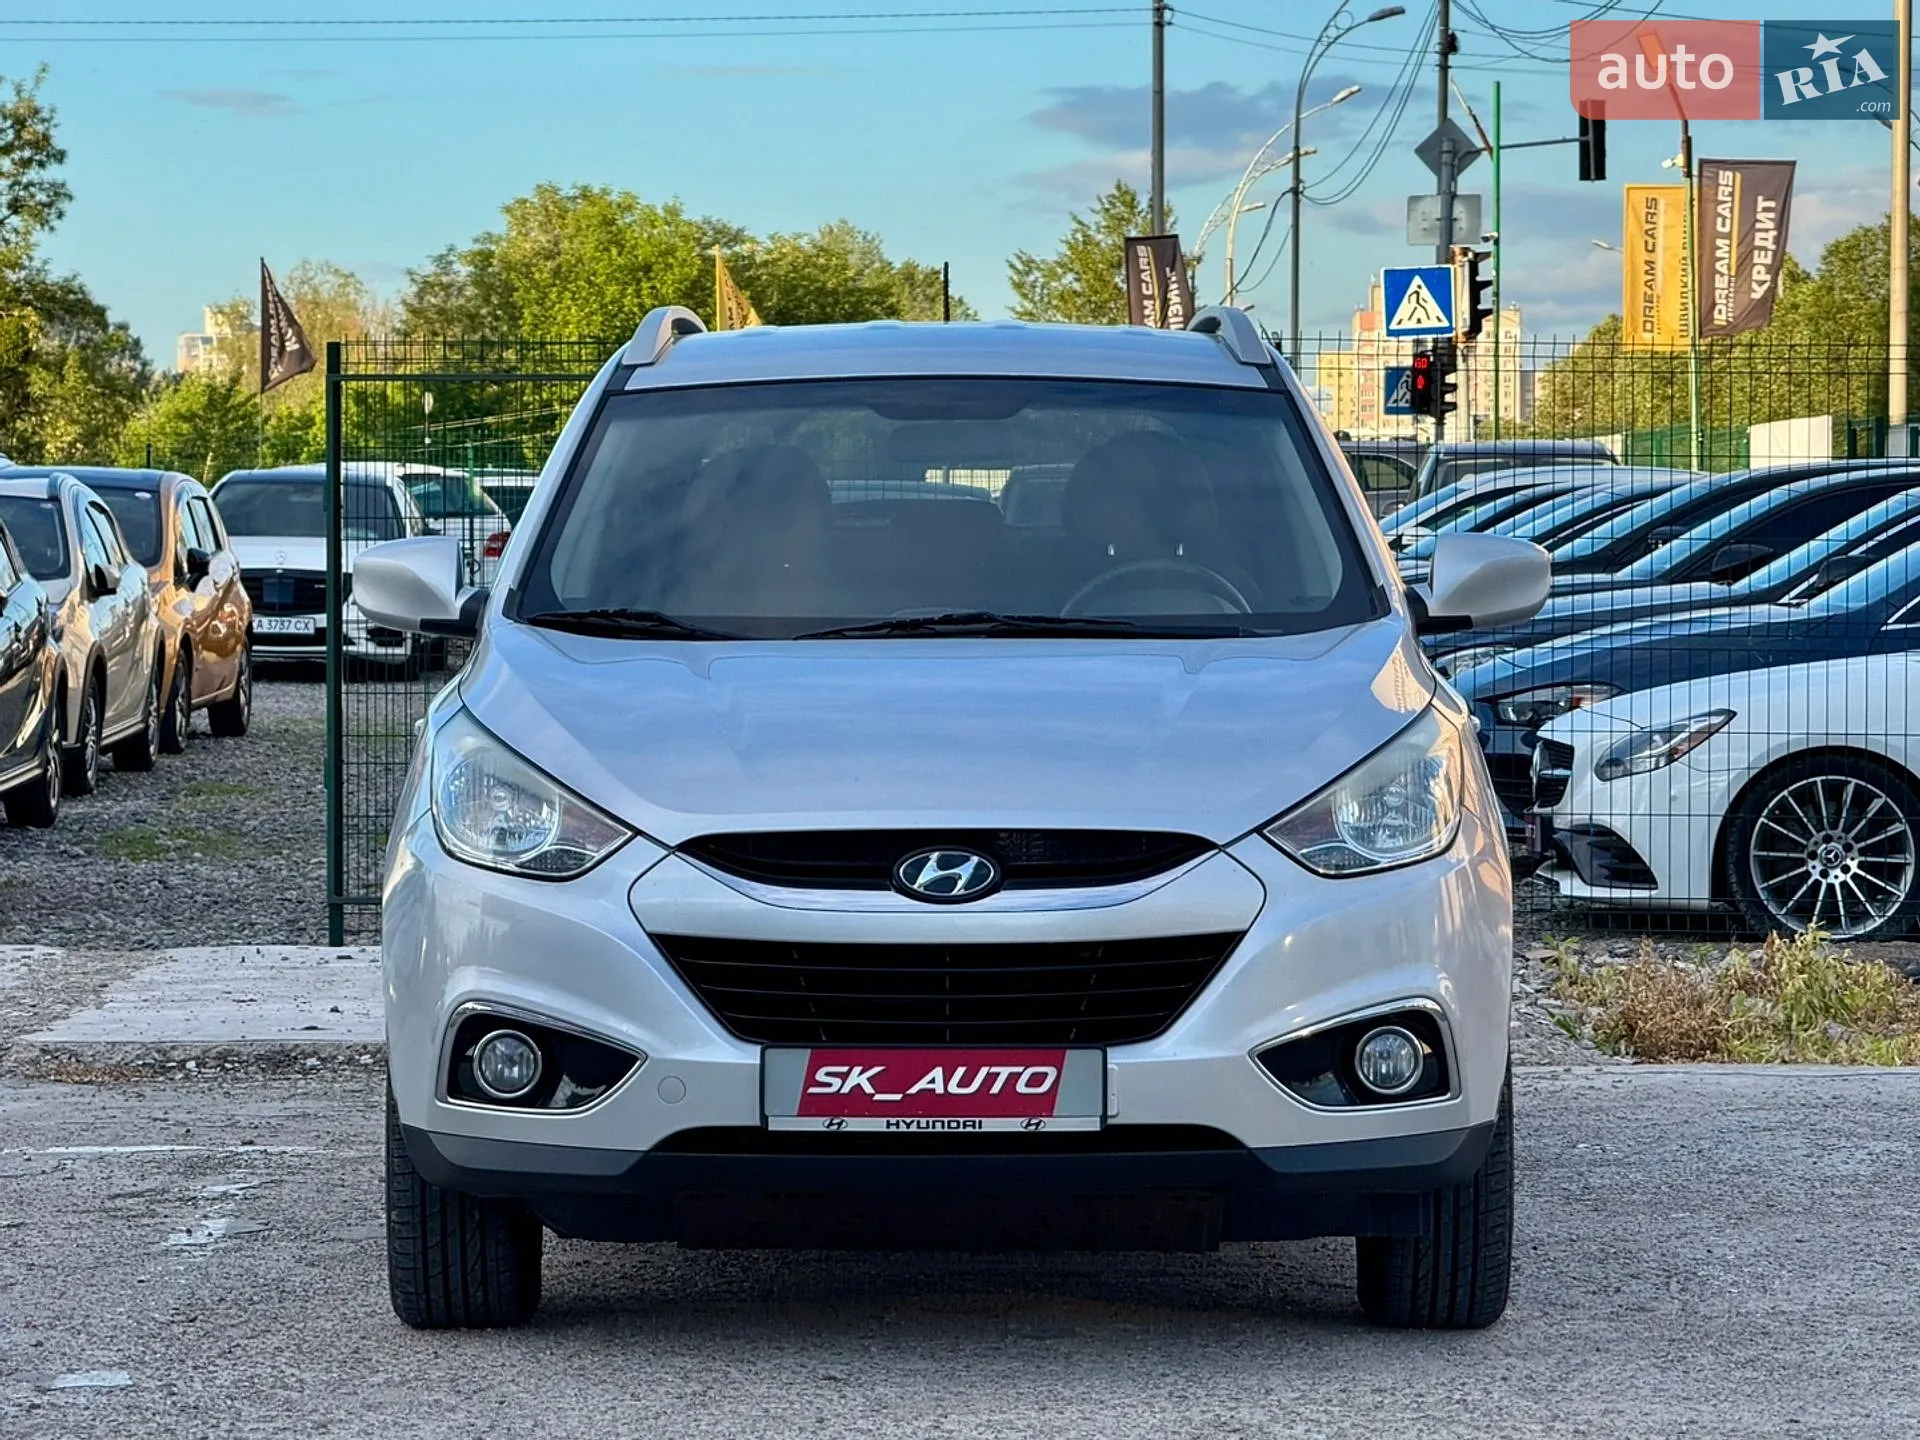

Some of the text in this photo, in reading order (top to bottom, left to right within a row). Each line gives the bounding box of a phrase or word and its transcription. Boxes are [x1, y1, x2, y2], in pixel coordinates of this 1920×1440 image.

[1136, 245, 1153, 295] CARS
[1642, 196, 1658, 334] DREAM CARS
[1713, 170, 1734, 322] DREAM CARS
[1750, 195, 1778, 299] КРЕДИТ
[806, 1066, 1059, 1101] SK_AUTO
[885, 1119, 983, 1130] HYUNDAI
